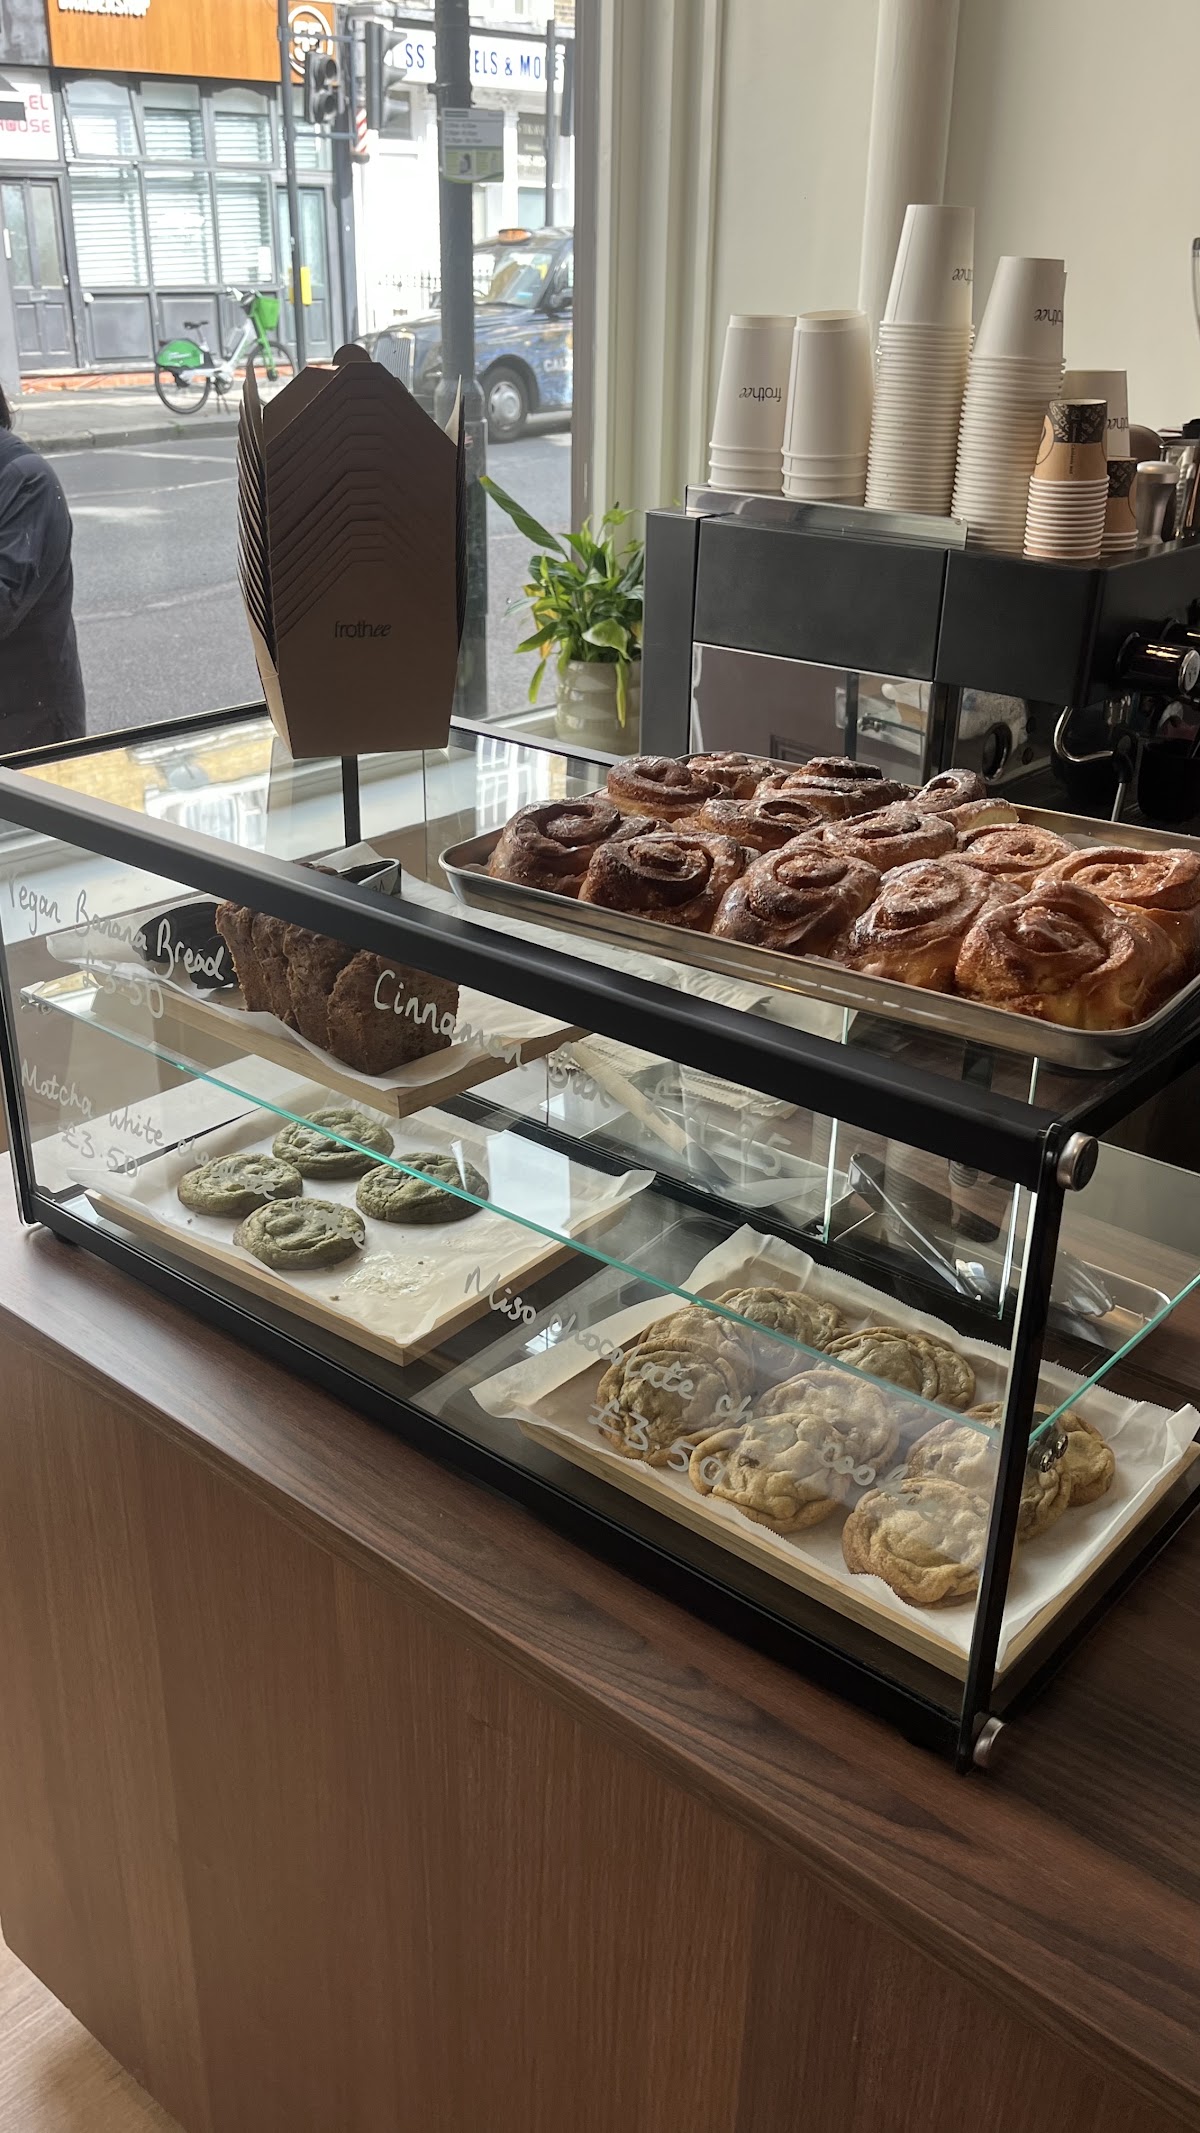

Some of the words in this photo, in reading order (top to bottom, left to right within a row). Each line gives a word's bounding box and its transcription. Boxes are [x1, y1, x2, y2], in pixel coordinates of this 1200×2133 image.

[474, 50, 498, 75] ELS
[504, 57, 513, 76] &
[520, 54, 541, 79] MO
[739, 387, 782, 403] frothee
[334, 620, 392, 638] frothee
[7, 872, 60, 935] Vegan
[75, 889, 148, 950] Banana
[154, 919, 225, 980] Bread
[373, 969, 528, 1071] Cinnamon
[21, 1059, 94, 1119] Matcha
[58, 1125, 138, 1178] £3.50
[464, 1266, 536, 1325] Miso
[586, 1402, 730, 1488] £3.50
